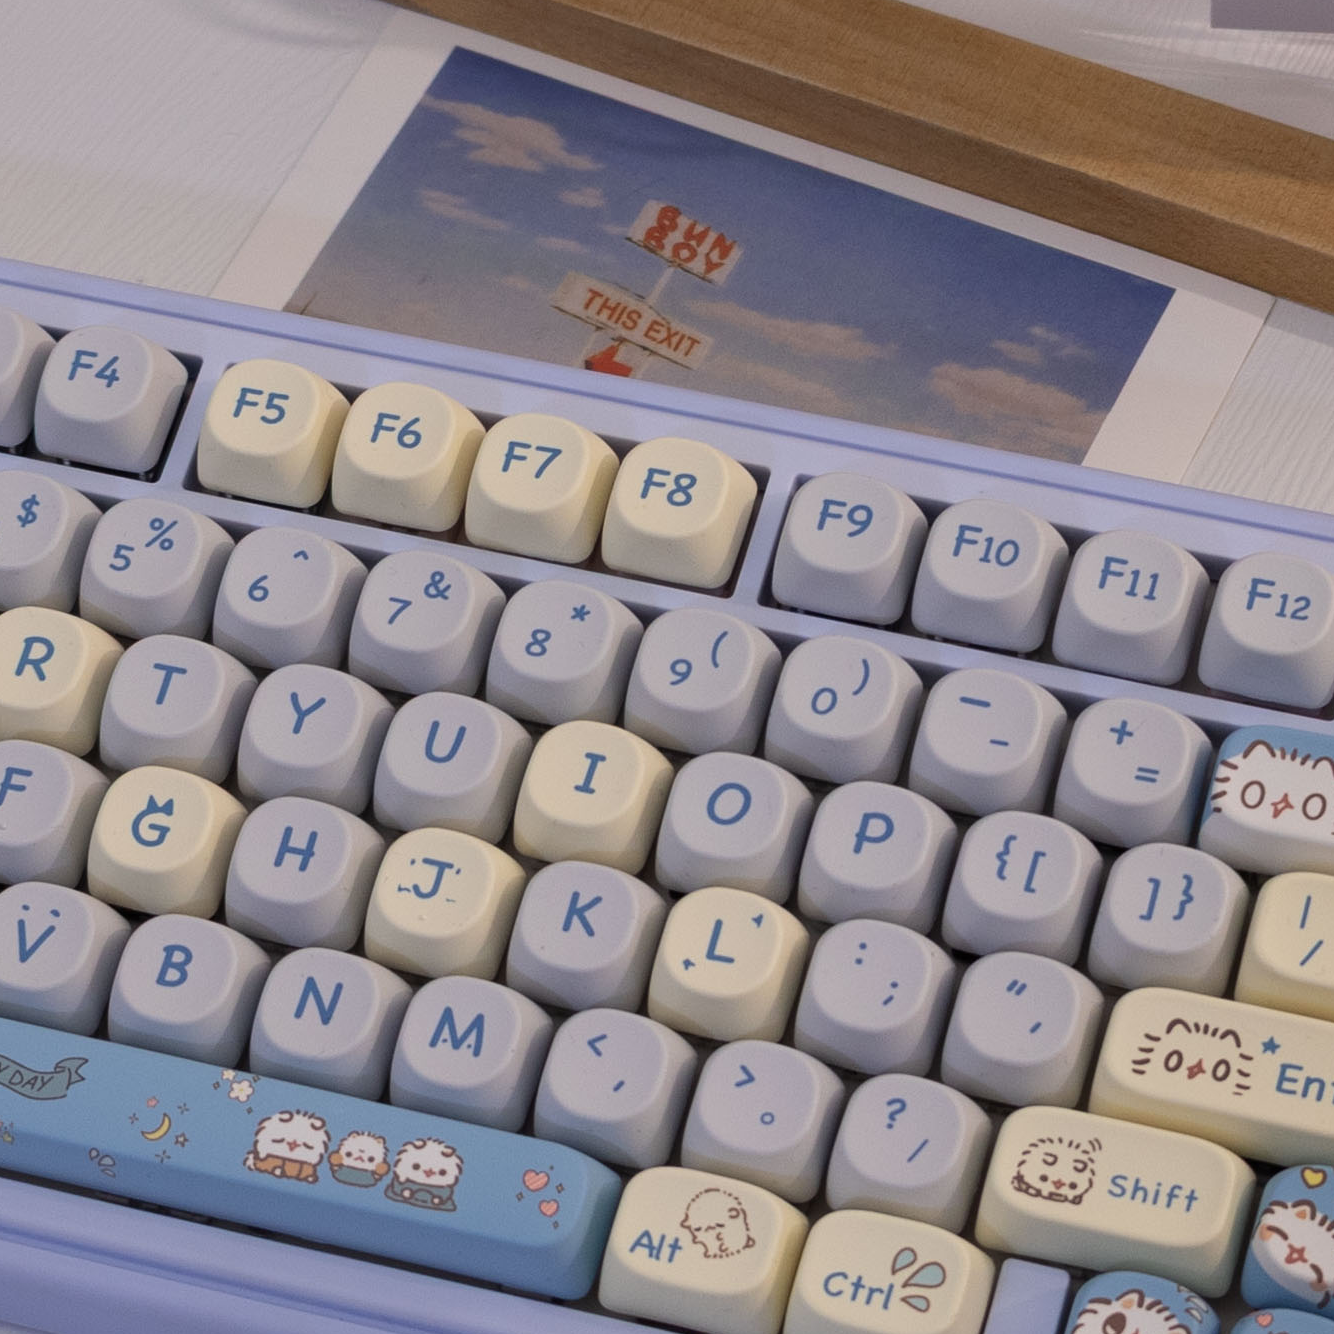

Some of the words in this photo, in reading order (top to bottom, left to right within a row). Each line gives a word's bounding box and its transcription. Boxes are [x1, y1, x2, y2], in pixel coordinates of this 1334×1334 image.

[583, 288, 642, 331] THIS
[643, 319, 701, 357] EXIT
[67, 349, 120, 388] F4
[233, 387, 290, 425] F5
[370, 412, 422, 449] F6
[501, 440, 563, 479] F7
[640, 467, 698, 507] F8
[817, 498, 874, 538] F9
[109, 544, 135, 572] 5
[952, 524, 1020, 567] F10
[247, 574, 269, 603] 6
[1098, 556, 1159, 601] F11
[1246, 577, 1311, 621] F12
[388, 597, 412, 625] 7
[14, 636, 55, 682] R
[525, 628, 552, 657] 8
[153, 662, 188, 705] T
[669, 658, 693, 686] 9
[290, 691, 327, 735] Y
[811, 687, 838, 716] 0
[424, 720, 467, 764] U
[573, 752, 607, 795] I
[706, 782, 752, 826] O
[273, 826, 318, 872] H
[853, 812, 895, 855] P
[562, 890, 603, 938] K
[155, 944, 193, 988] B
[293, 976, 344, 1026] N
[428, 1006, 485, 1058] M
[8, 1070, 54, 1091] DAY
[1107, 1174, 1199, 1213] Shift
[629, 1229, 683, 1264] Alt
[823, 1271, 896, 1310] Ctrl
